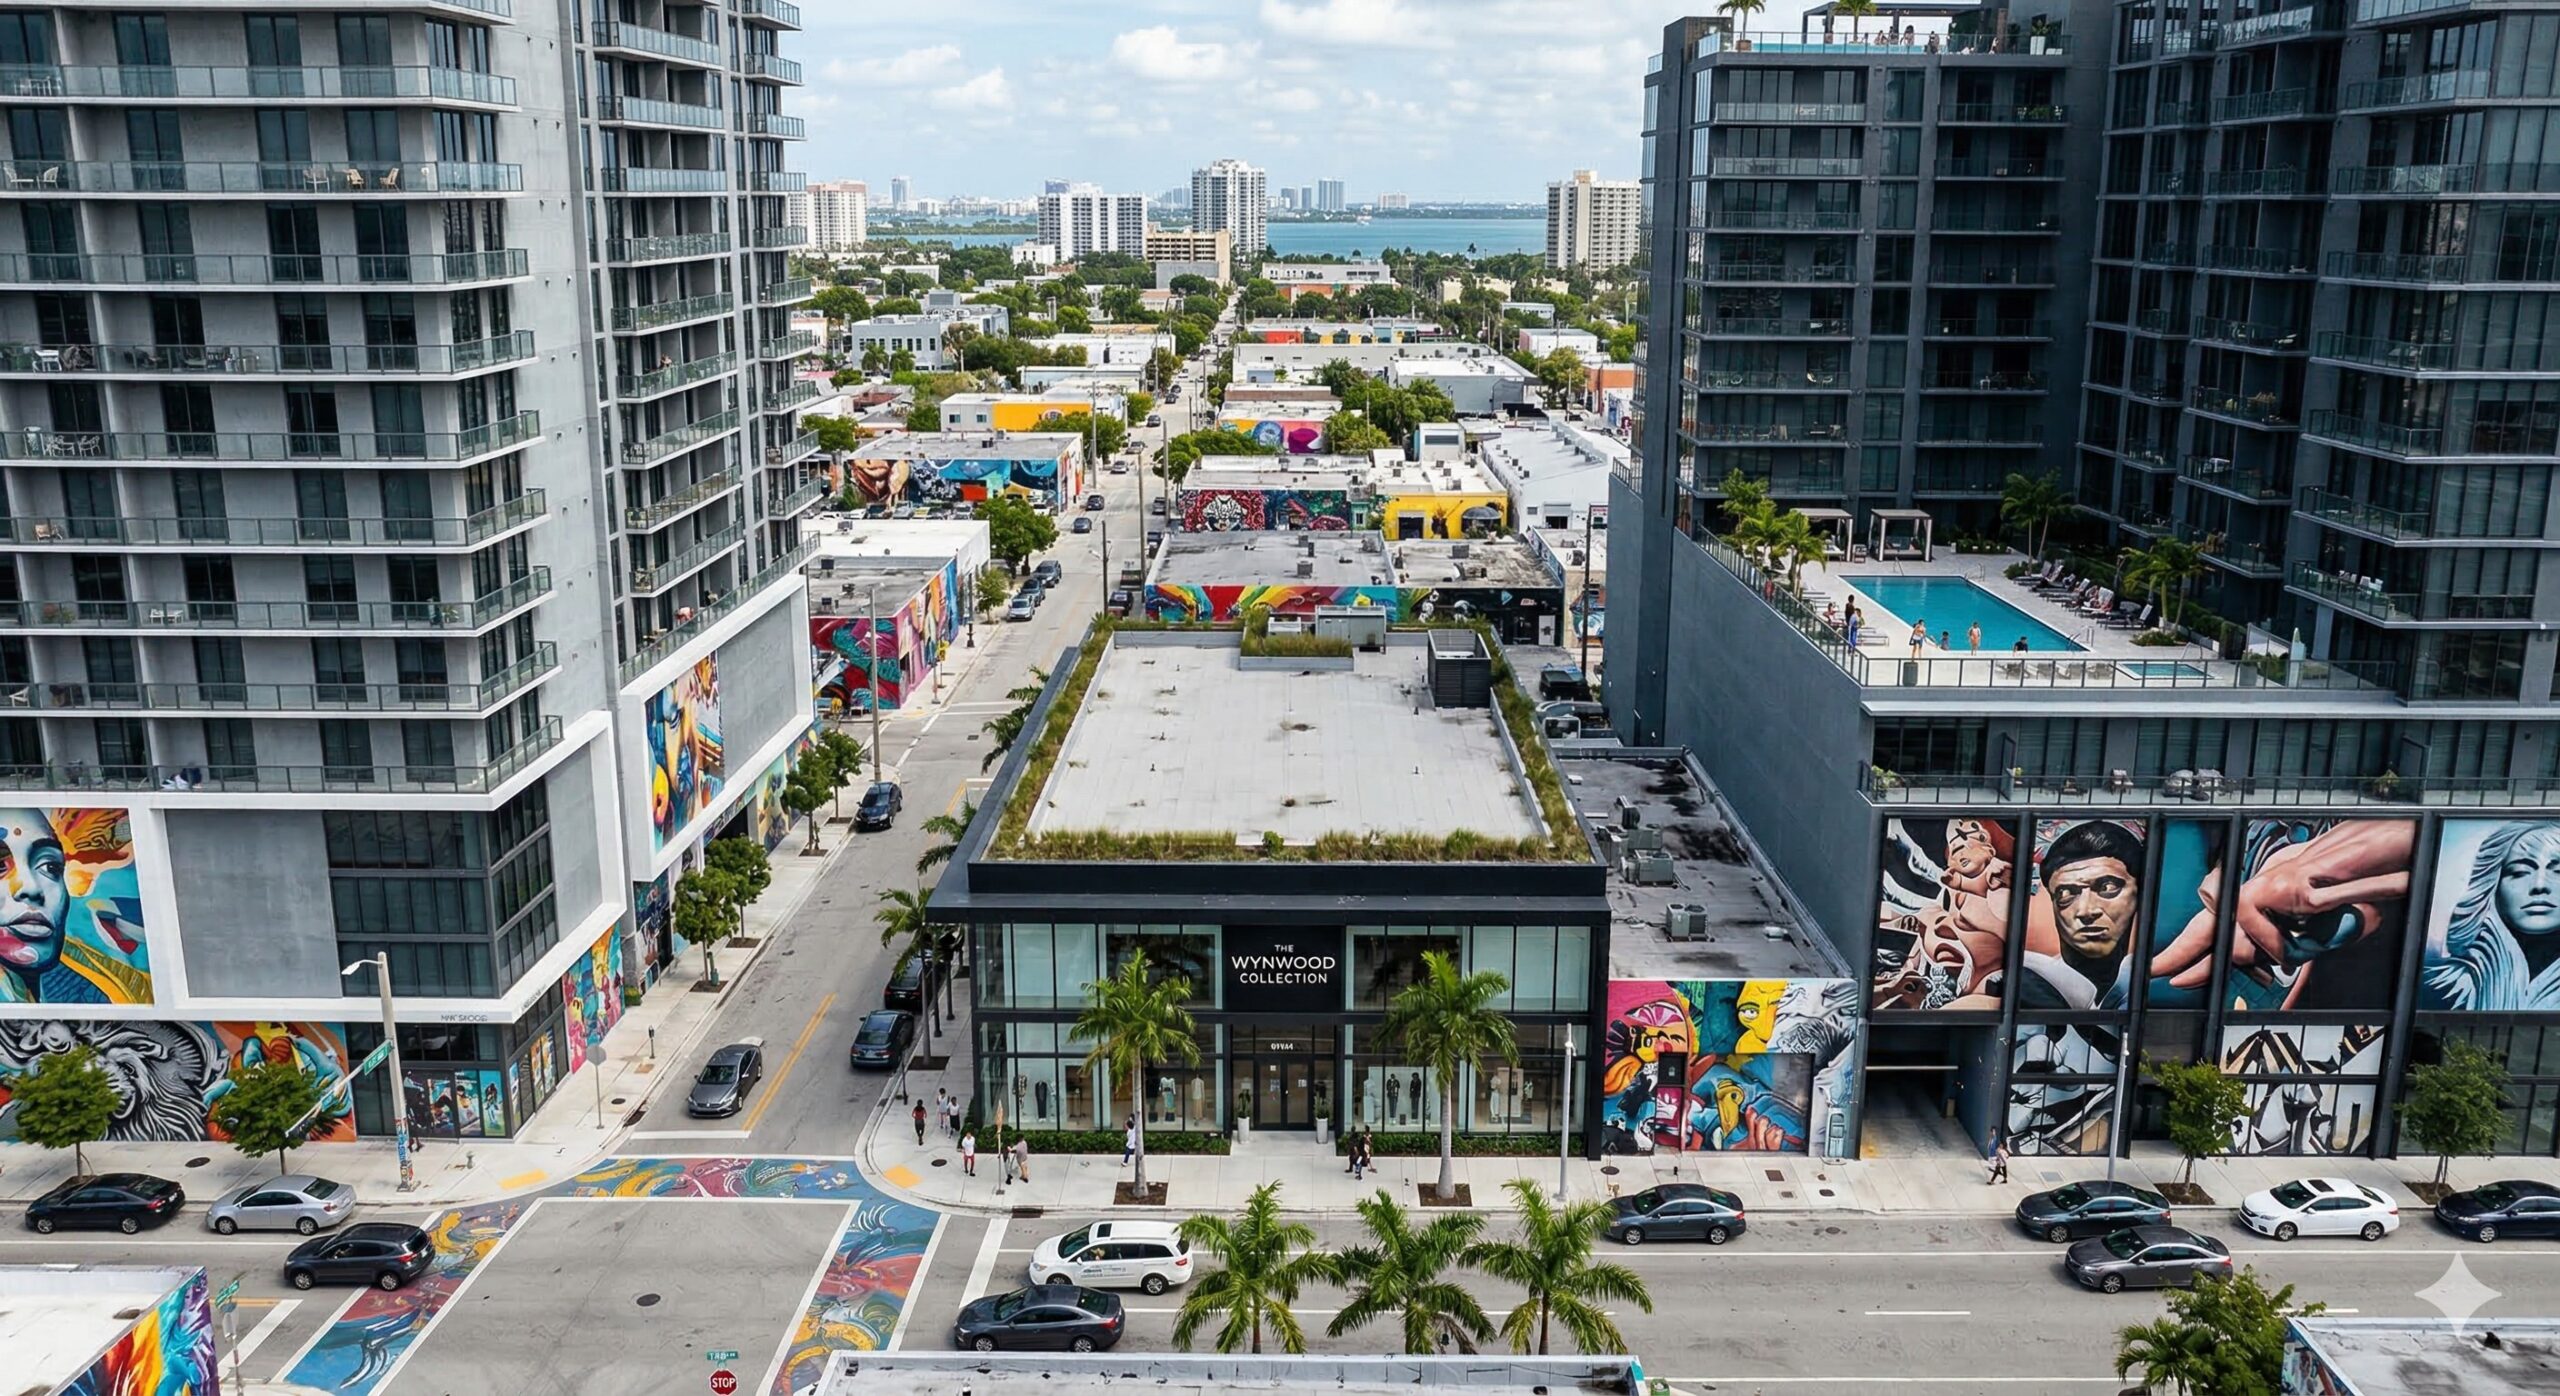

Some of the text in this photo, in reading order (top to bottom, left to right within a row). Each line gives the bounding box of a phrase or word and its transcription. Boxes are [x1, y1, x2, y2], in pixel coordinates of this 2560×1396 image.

[1232, 956, 1335, 969] WYNWOOD
[1240, 973, 1327, 984] COLLECTION
[712, 1377, 736, 1388] STOP
